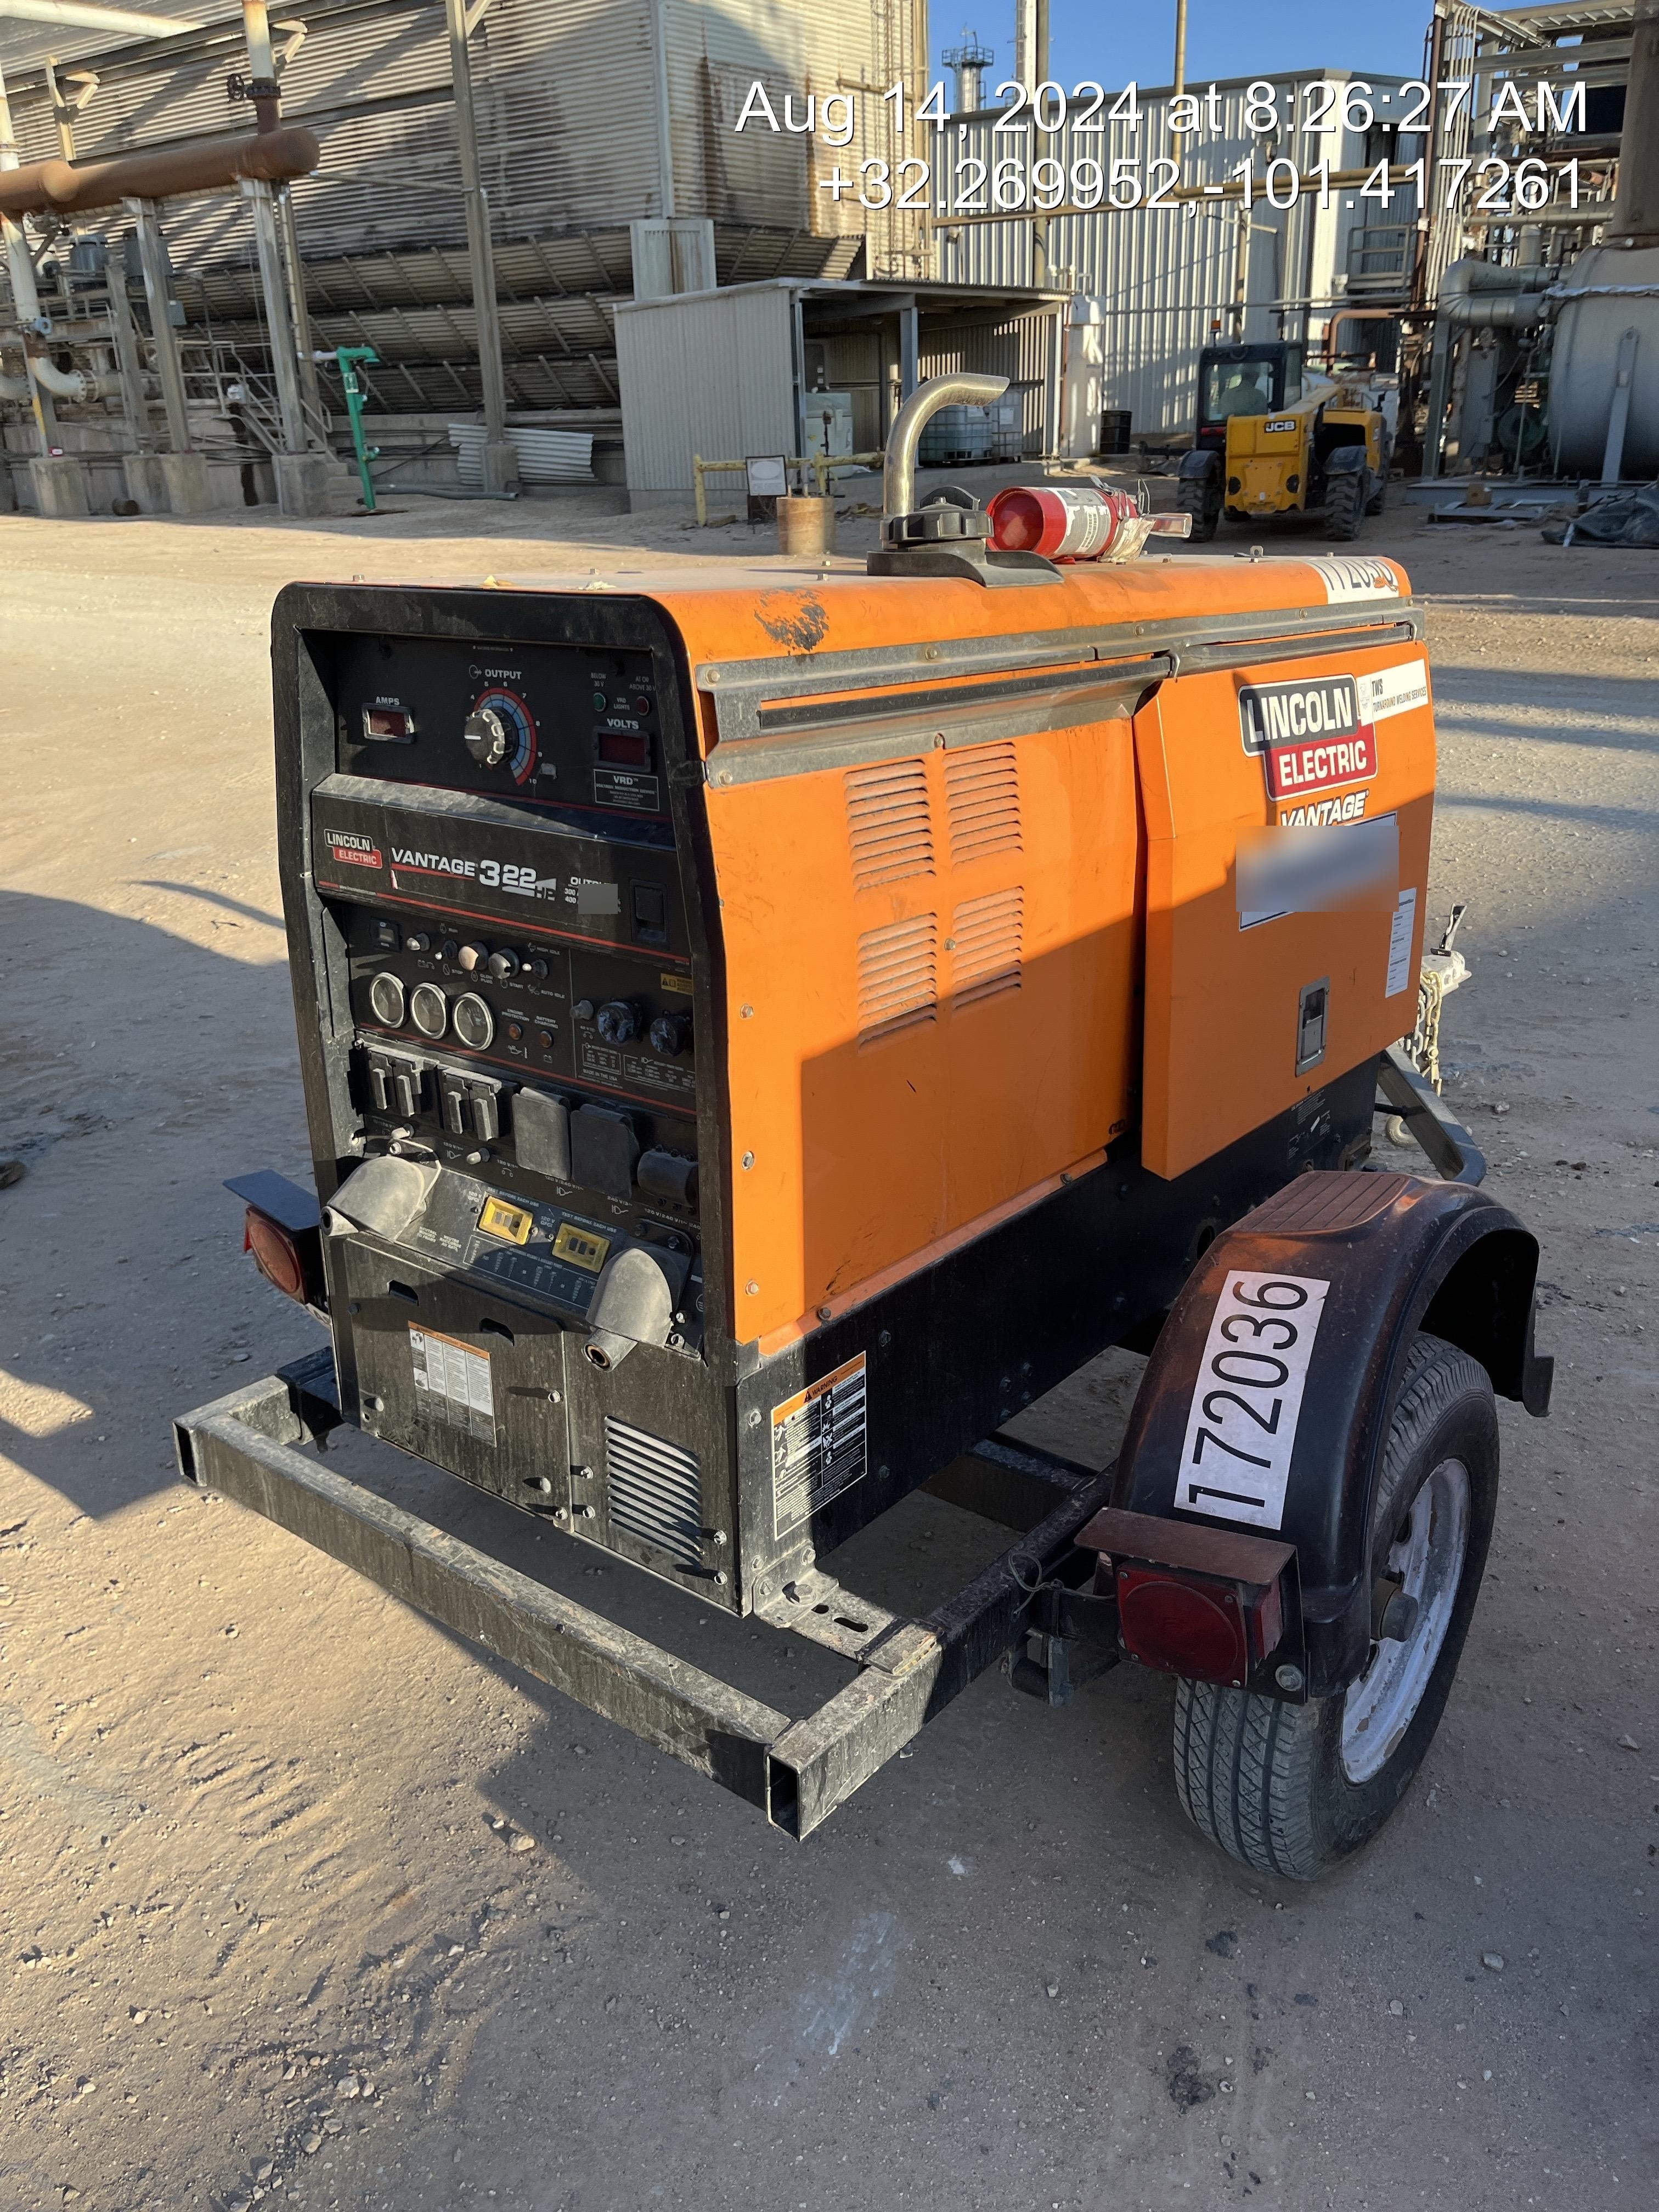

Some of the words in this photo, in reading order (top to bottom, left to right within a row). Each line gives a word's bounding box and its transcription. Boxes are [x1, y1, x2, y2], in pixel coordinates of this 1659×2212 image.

[1265, 421, 1295, 432] JCB
[484, 669, 522, 680] OUTPUT
[1372, 678, 1383, 697] TWS
[1396, 691, 1411, 705] WELDING
[1411, 686, 1426, 700] SERVICES
[375, 696, 400, 706] AMPS
[607, 718, 639, 730] VOLTS
[1246, 687, 1353, 743] LINCOLN
[1279, 740, 1367, 787] ELECTRIC
[327, 833, 370, 851] LINCOLN
[338, 849, 377, 865] ELECTRIC
[391, 847, 476, 877] VANTAGE
[479, 859, 537, 889] 322
[812, 1375, 838, 1396] WARNING
[1188, 1280, 1308, 1508] 172036
